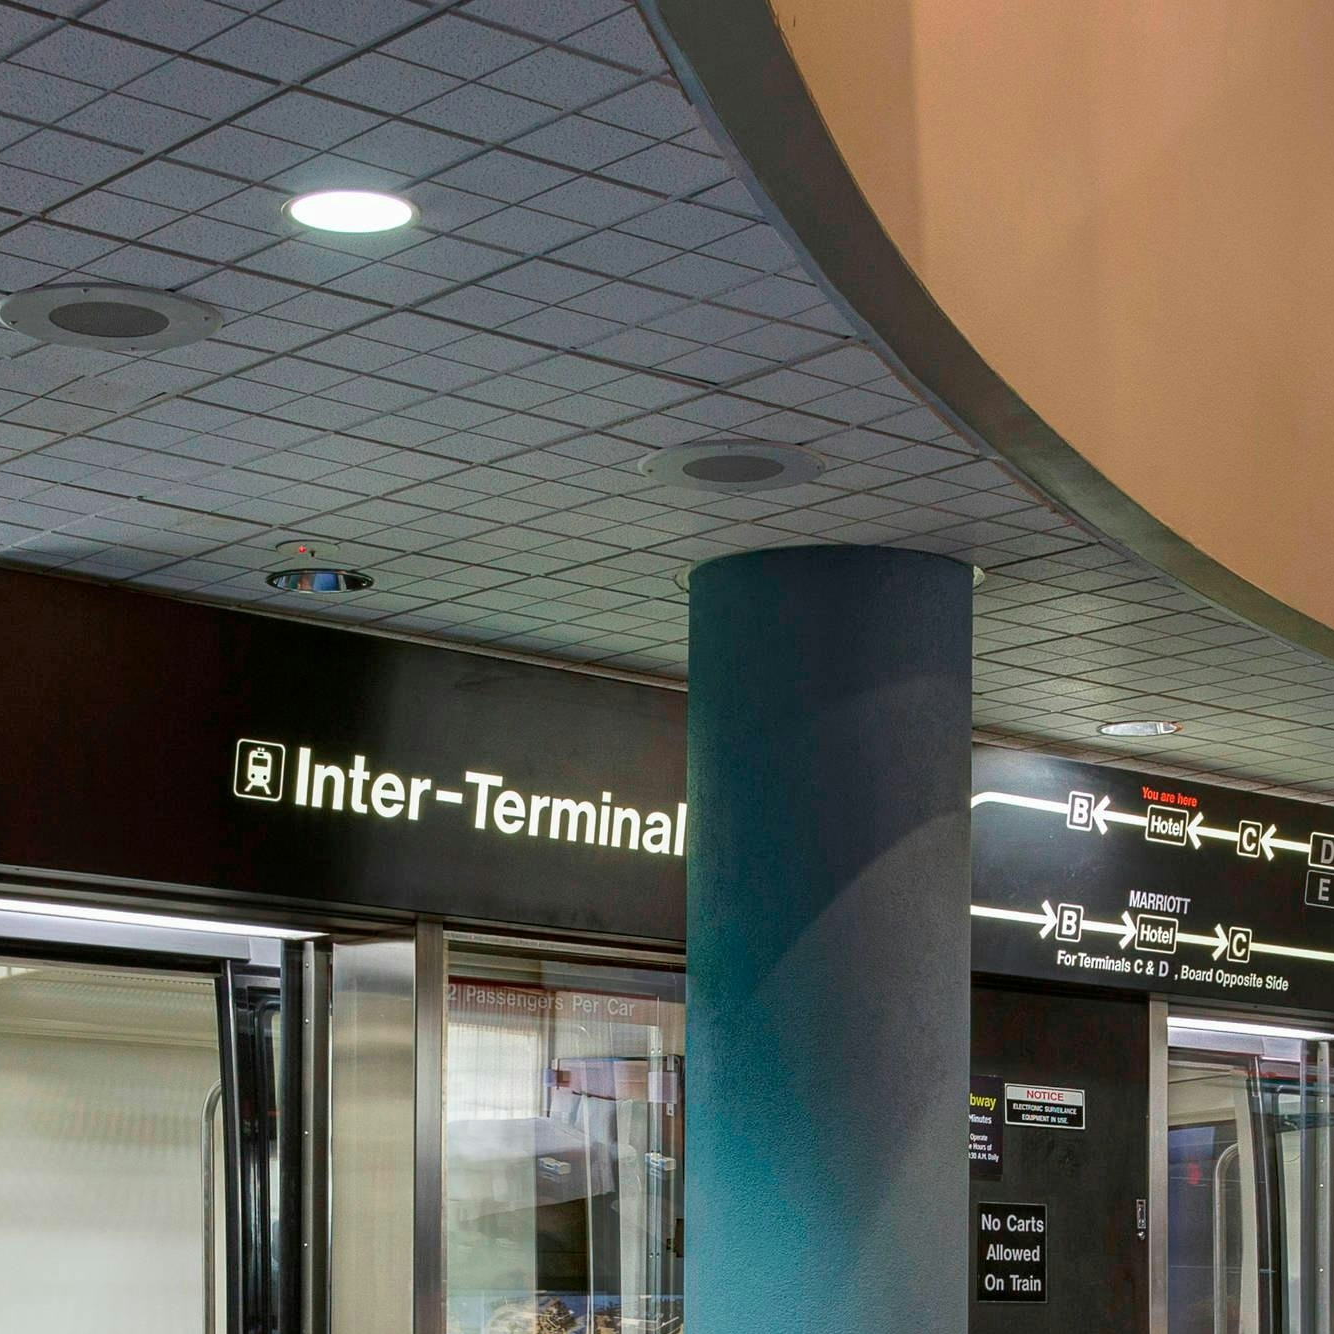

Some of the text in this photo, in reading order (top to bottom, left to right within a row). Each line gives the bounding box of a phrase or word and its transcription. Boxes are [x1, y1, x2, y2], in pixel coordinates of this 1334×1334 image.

[295, 746, 687, 857] Inter-Terminal
[1142, 786, 1198, 808] You are here
[1072, 797, 1089, 824] B
[1150, 815, 1184, 837] Hotel
[1242, 827, 1257, 852] C
[1320, 839, 1334, 864] D
[1318, 878, 1331, 901] E
[1129, 890, 1191, 915] MARRIOTT
[1061, 910, 1078, 936] B
[1139, 923, 1174, 945] Hotel
[1232, 933, 1247, 957] C
[1057, 950, 1076, 966] For
[1078, 953, 1131, 973] Terminals
[1134, 959, 1143, 974] C
[1146, 961, 1154, 976] &
[1158, 961, 1169, 977] D
[1181, 965, 1212, 983] Board
[1216, 970, 1264, 988] Opposite
[1266, 975, 1289, 991] Side
[466, 984, 564, 1011] Passengers
[571, 995, 599, 1013] Per
[607, 998, 636, 1017] Car
[970, 1093, 996, 1111] bway
[1026, 1090, 1064, 1102] NOTICE
[981, 1213, 1044, 1232] No Carts
[986, 1243, 1040, 1262] Allowed
[985, 1273, 1042, 1292] On Train
